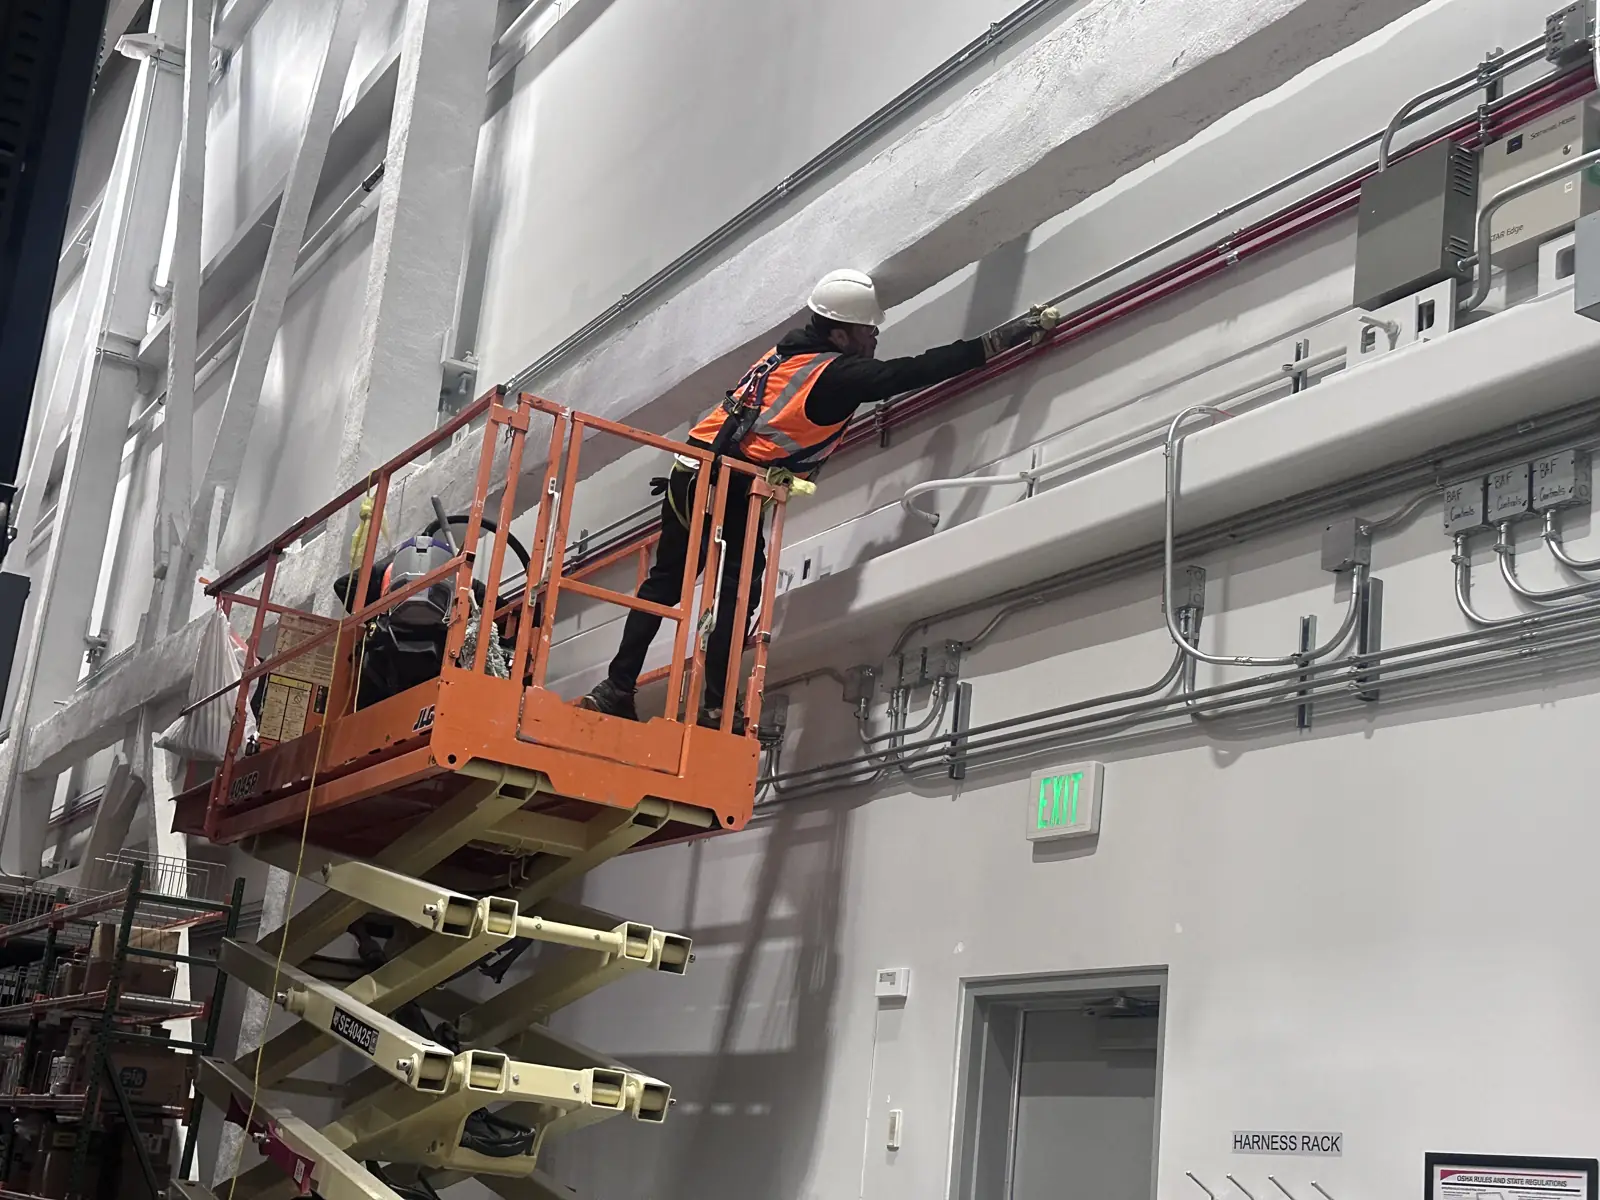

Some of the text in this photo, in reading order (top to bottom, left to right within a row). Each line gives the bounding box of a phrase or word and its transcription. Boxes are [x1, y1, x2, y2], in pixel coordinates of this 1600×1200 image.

[1506, 224, 1524, 236] Edge
[1538, 458, 1559, 479] BAF
[1494, 470, 1514, 489] BAF
[1446, 487, 1463, 502] BAF
[1037, 771, 1084, 829] EXIT
[338, 1014, 372, 1048] SE40425
[1233, 1134, 1341, 1152] HARNESS RACK
[1473, 1175, 1493, 1183] RULES
[1506, 1177, 1525, 1185] STATE
[1525, 1178, 1567, 1188] REGULATIONS
